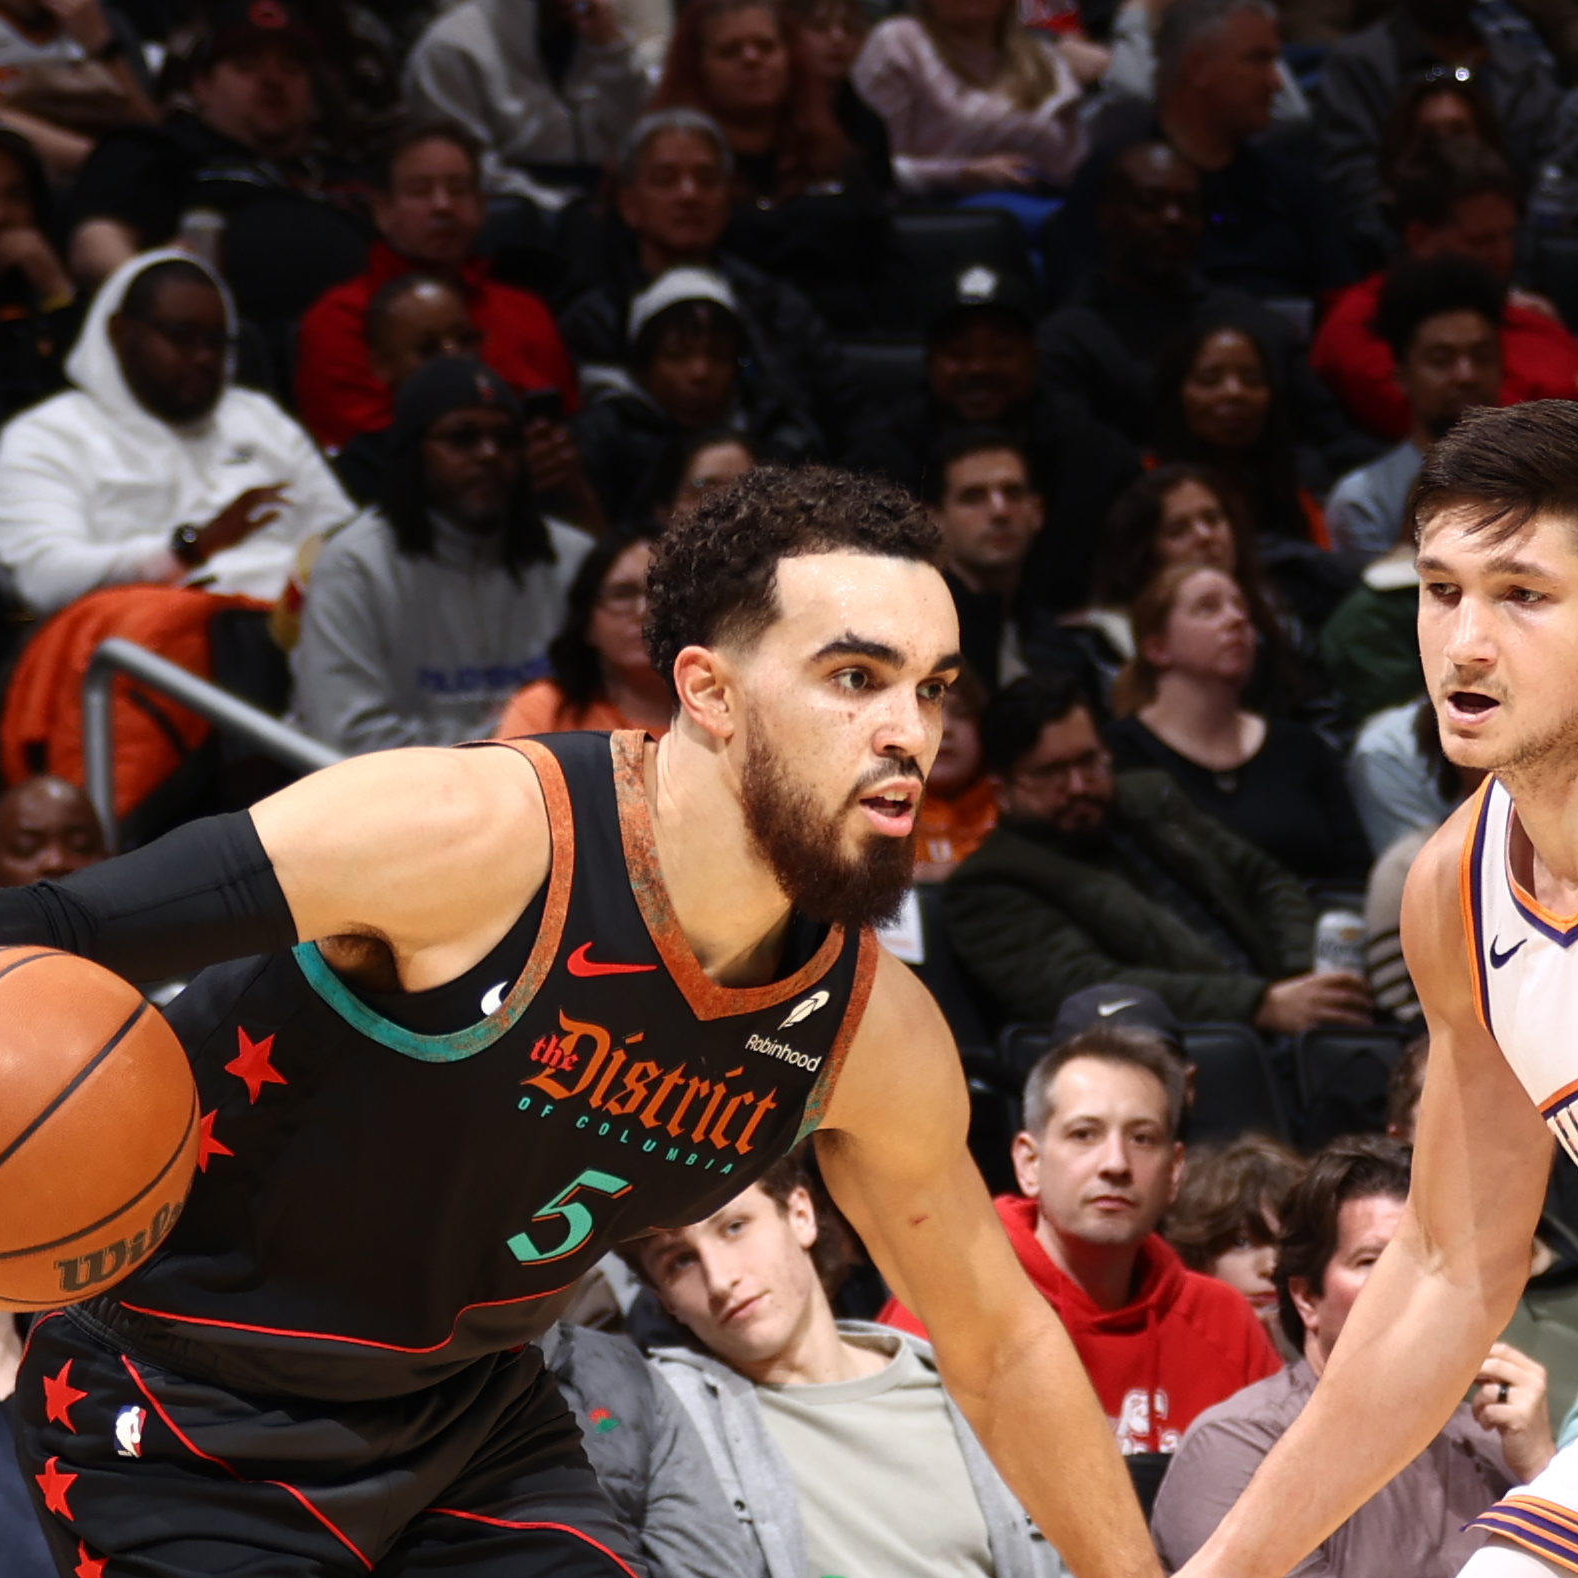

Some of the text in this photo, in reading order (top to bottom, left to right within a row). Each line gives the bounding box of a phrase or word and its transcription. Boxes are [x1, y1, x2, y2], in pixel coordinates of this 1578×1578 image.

[520, 1009, 778, 1155] District
[529, 1034, 579, 1072] the
[745, 1033, 822, 1073] Robinhood
[517, 1096, 734, 1175] OF COLUMBIA
[54, 1200, 186, 1293] Wil
[506, 1168, 634, 1267] 5
